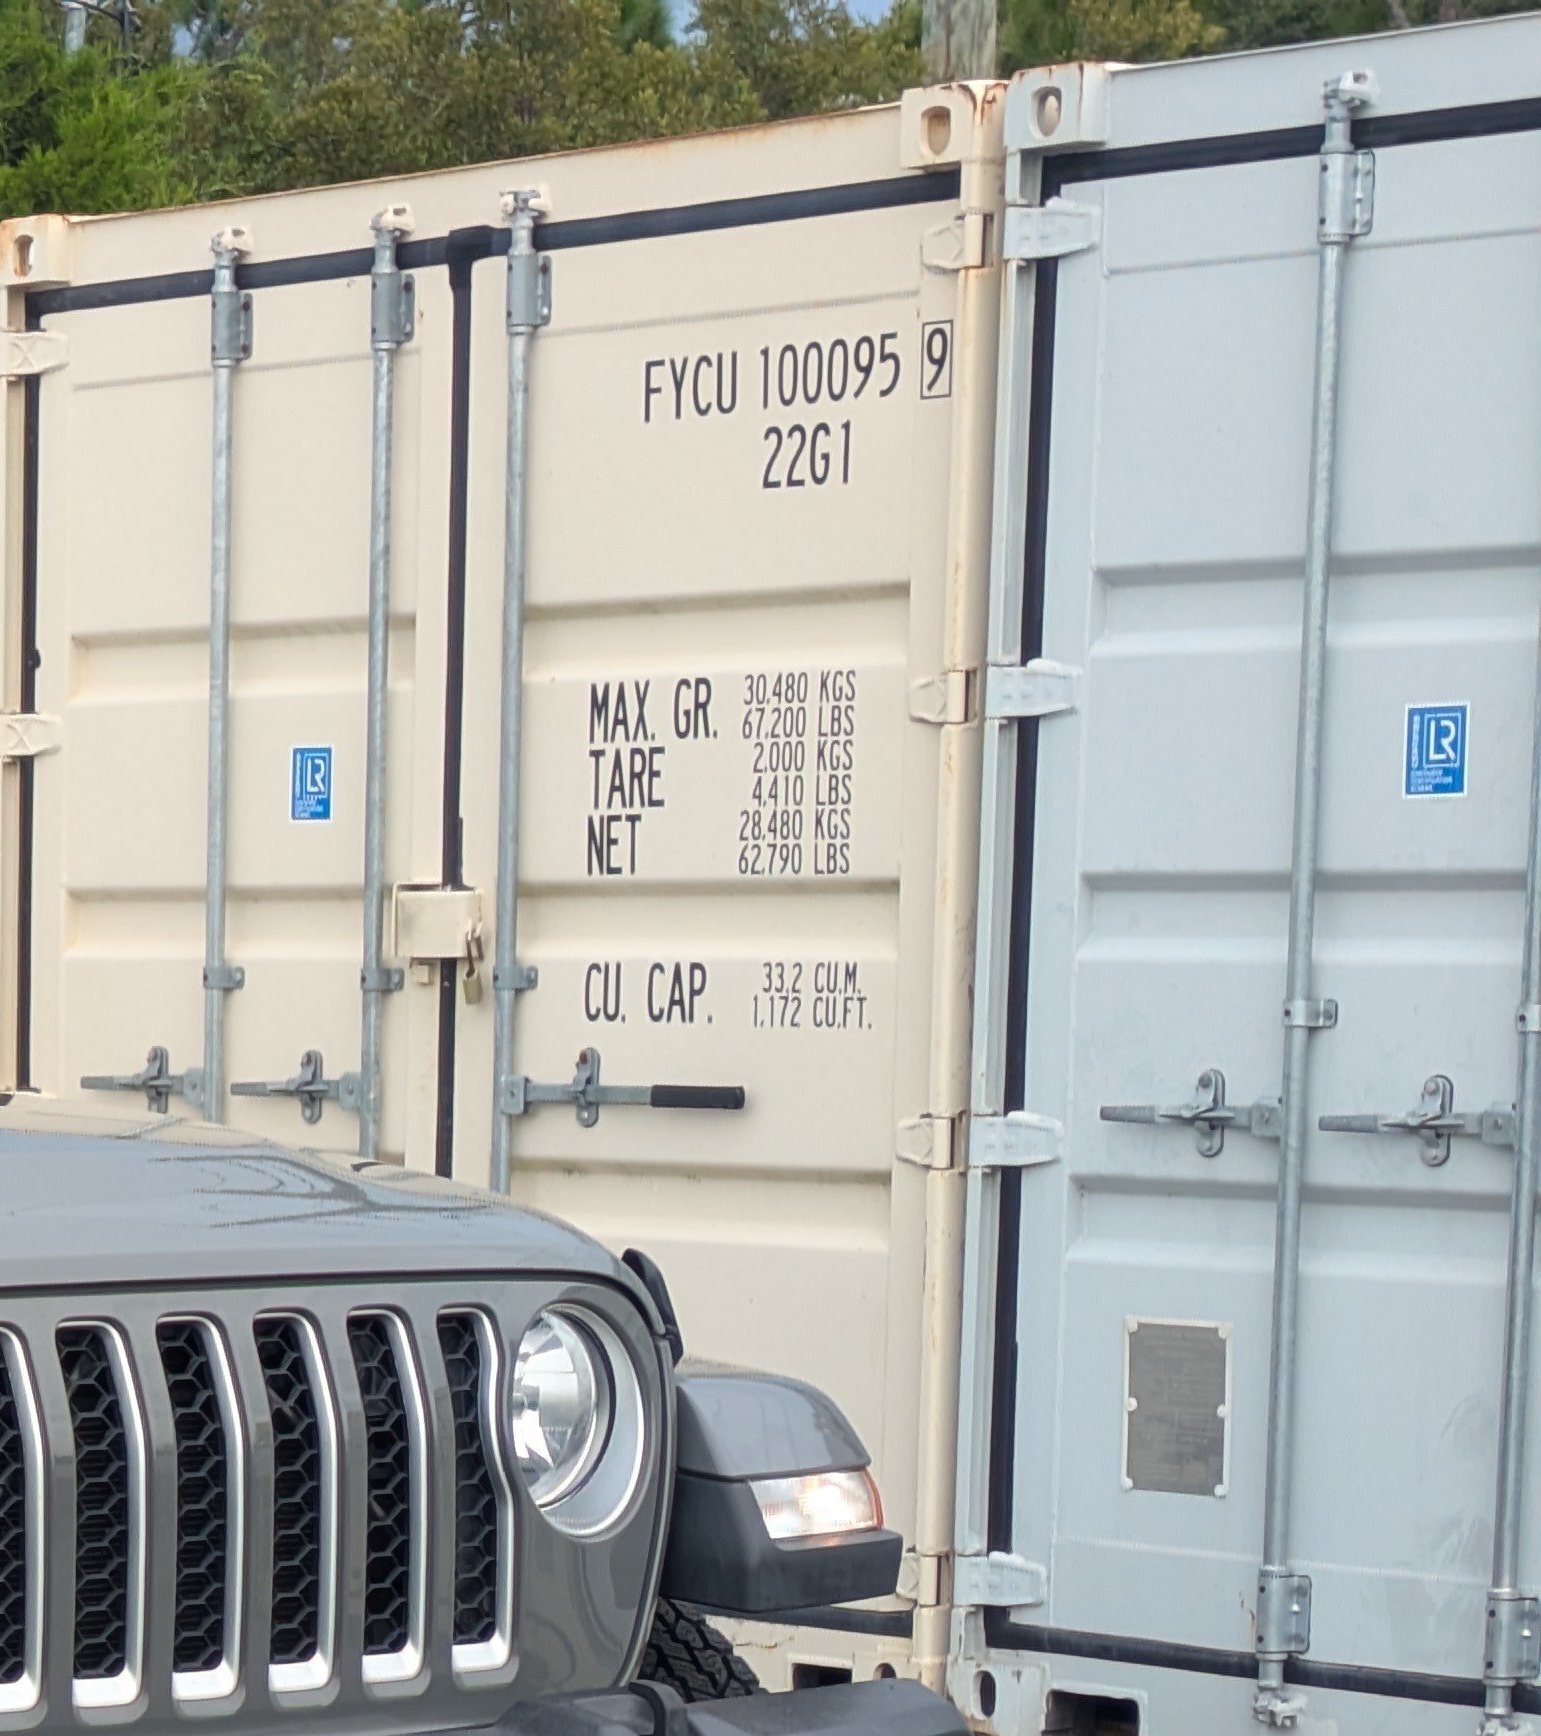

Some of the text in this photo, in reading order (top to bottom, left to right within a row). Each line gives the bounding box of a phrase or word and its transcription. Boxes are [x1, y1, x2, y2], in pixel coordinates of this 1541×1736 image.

[643, 327, 949, 424] FYCU 100095 9
[762, 418, 852, 489] 22G1
[588, 679, 656, 744] MAX.
[673, 677, 718, 740] GR.
[819, 669, 856, 703] KGS
[818, 704, 855, 738] LBS
[1428, 719, 1456, 761] LR
[306, 756, 325, 794] LR
[588, 746, 666, 810] TARE
[817, 739, 854, 773] KGS
[815, 773, 852, 806] LBS
[586, 813, 643, 877] NET
[814, 807, 852, 841] KGS
[814, 841, 850, 875] LBS
[584, 961, 627, 1024] CU.
[647, 961, 714, 1025] CAP.
